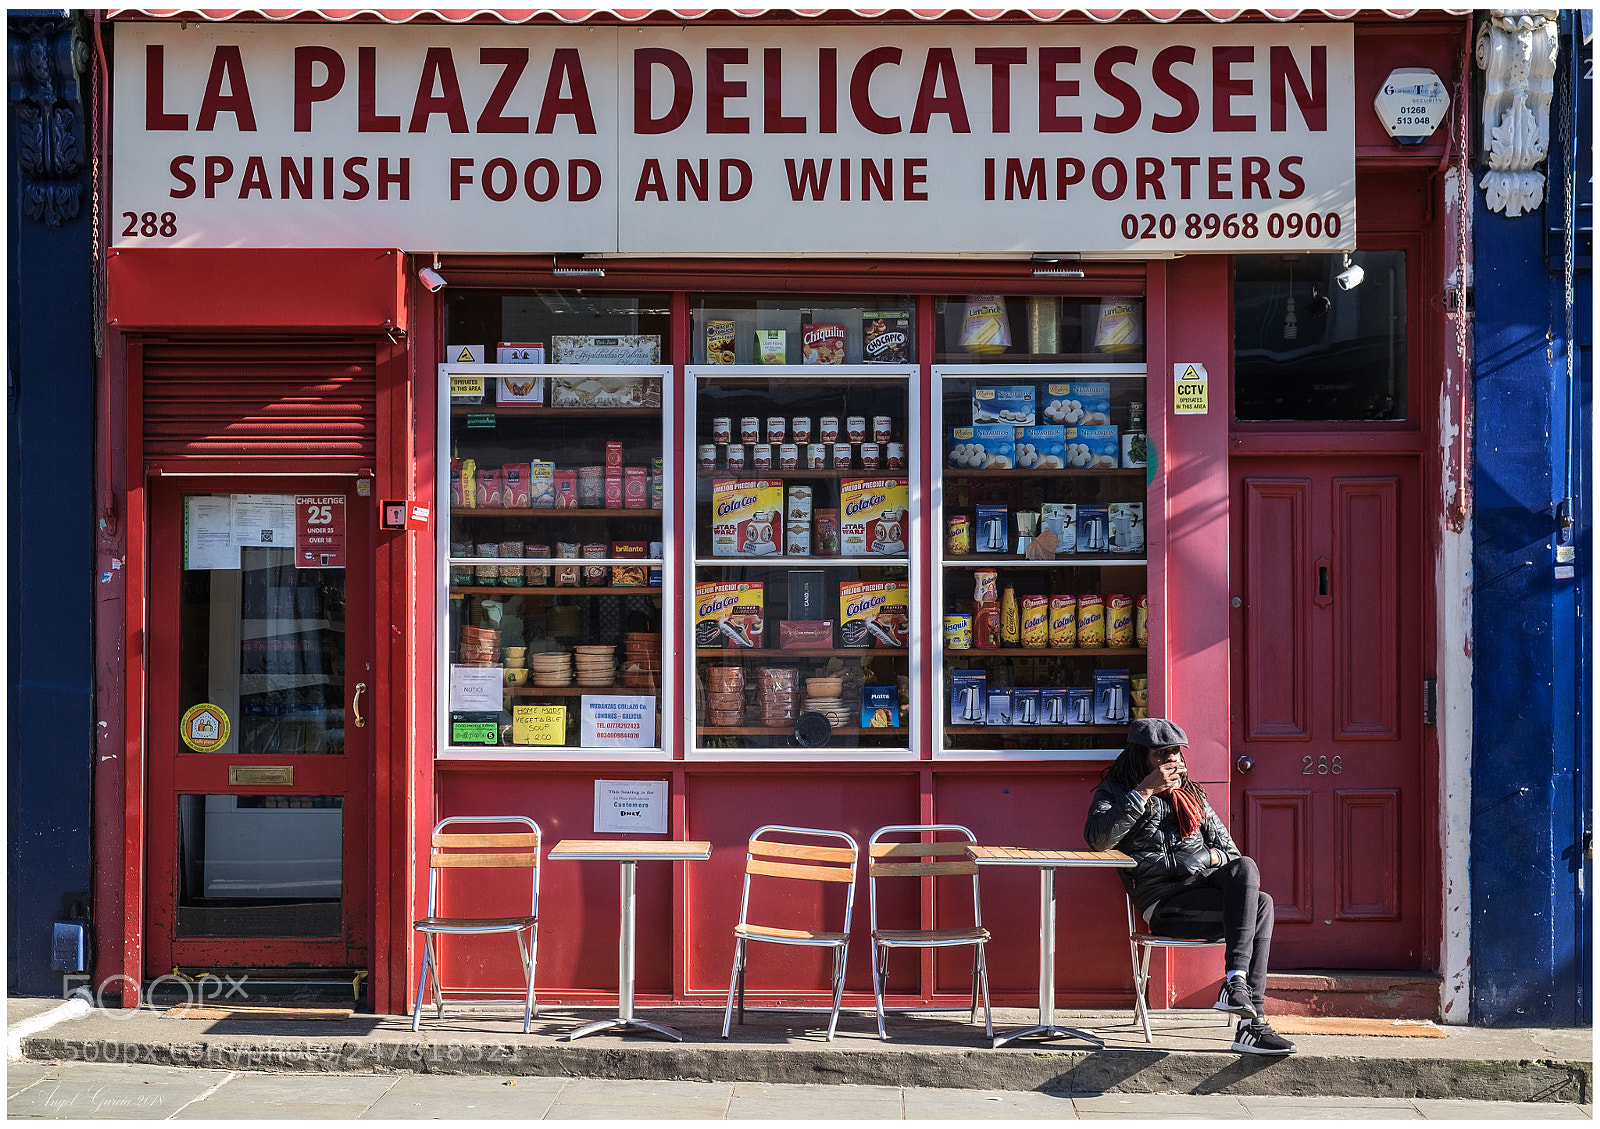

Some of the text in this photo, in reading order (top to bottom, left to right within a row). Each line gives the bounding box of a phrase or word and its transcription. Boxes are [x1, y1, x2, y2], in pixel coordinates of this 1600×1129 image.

[145, 44, 1329, 135] LA PLAZA DELICATESSEN
[1400, 106, 1426, 114] 01268
[169, 155, 1306, 202] SPANISH FOOD AND WINE IMPORTERS
[121, 211, 178, 238] 288
[1121, 212, 1342, 240] 020 8968 0900
[804, 326, 844, 345] Chiquilin
[867, 333, 903, 352] CHOCAPIC
[1178, 384, 1204, 395] CCTV
[308, 506, 332, 524] 25
[1302, 755, 1343, 775] 288
